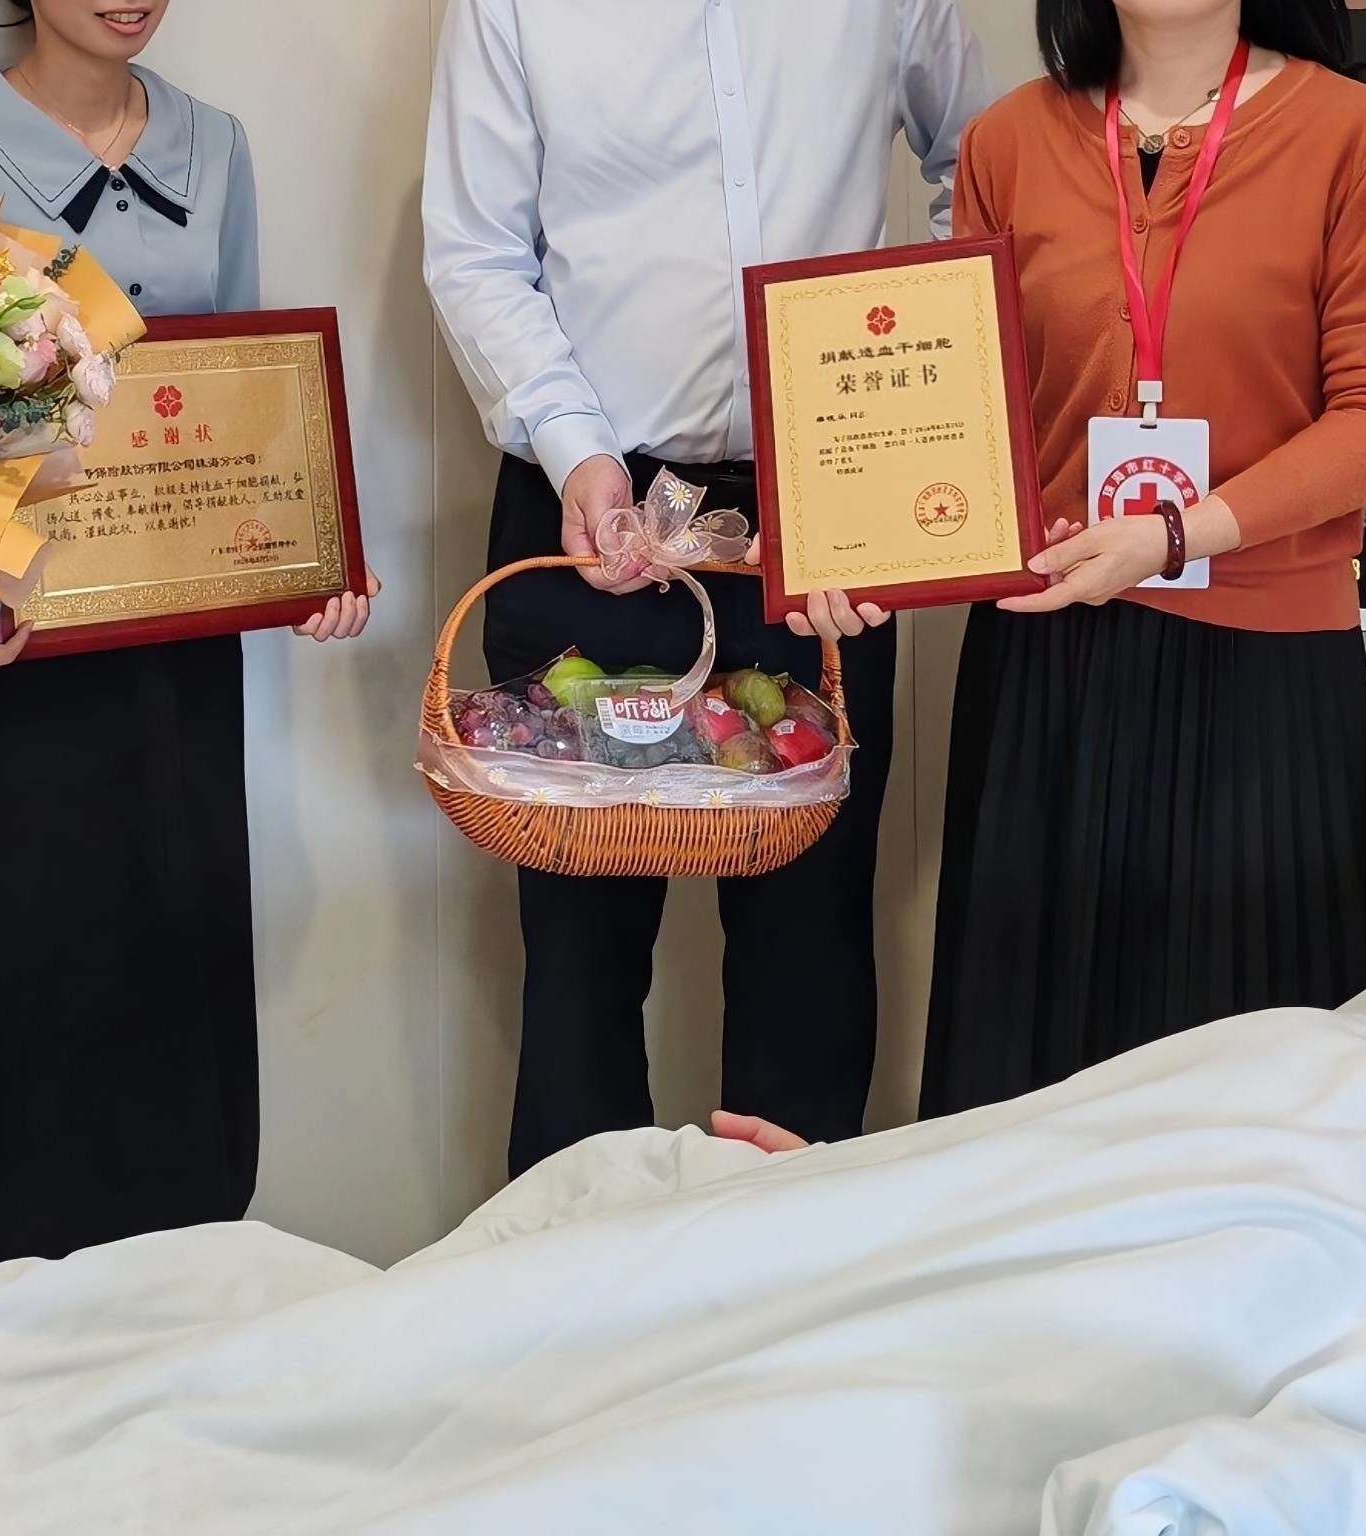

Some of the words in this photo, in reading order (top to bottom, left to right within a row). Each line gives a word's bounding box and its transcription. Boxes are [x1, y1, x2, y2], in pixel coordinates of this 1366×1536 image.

[819, 337, 954, 365] 捐献造血干细胞
[835, 364, 939, 396] 荣誉证书
[131, 423, 213, 449] 感谢状
